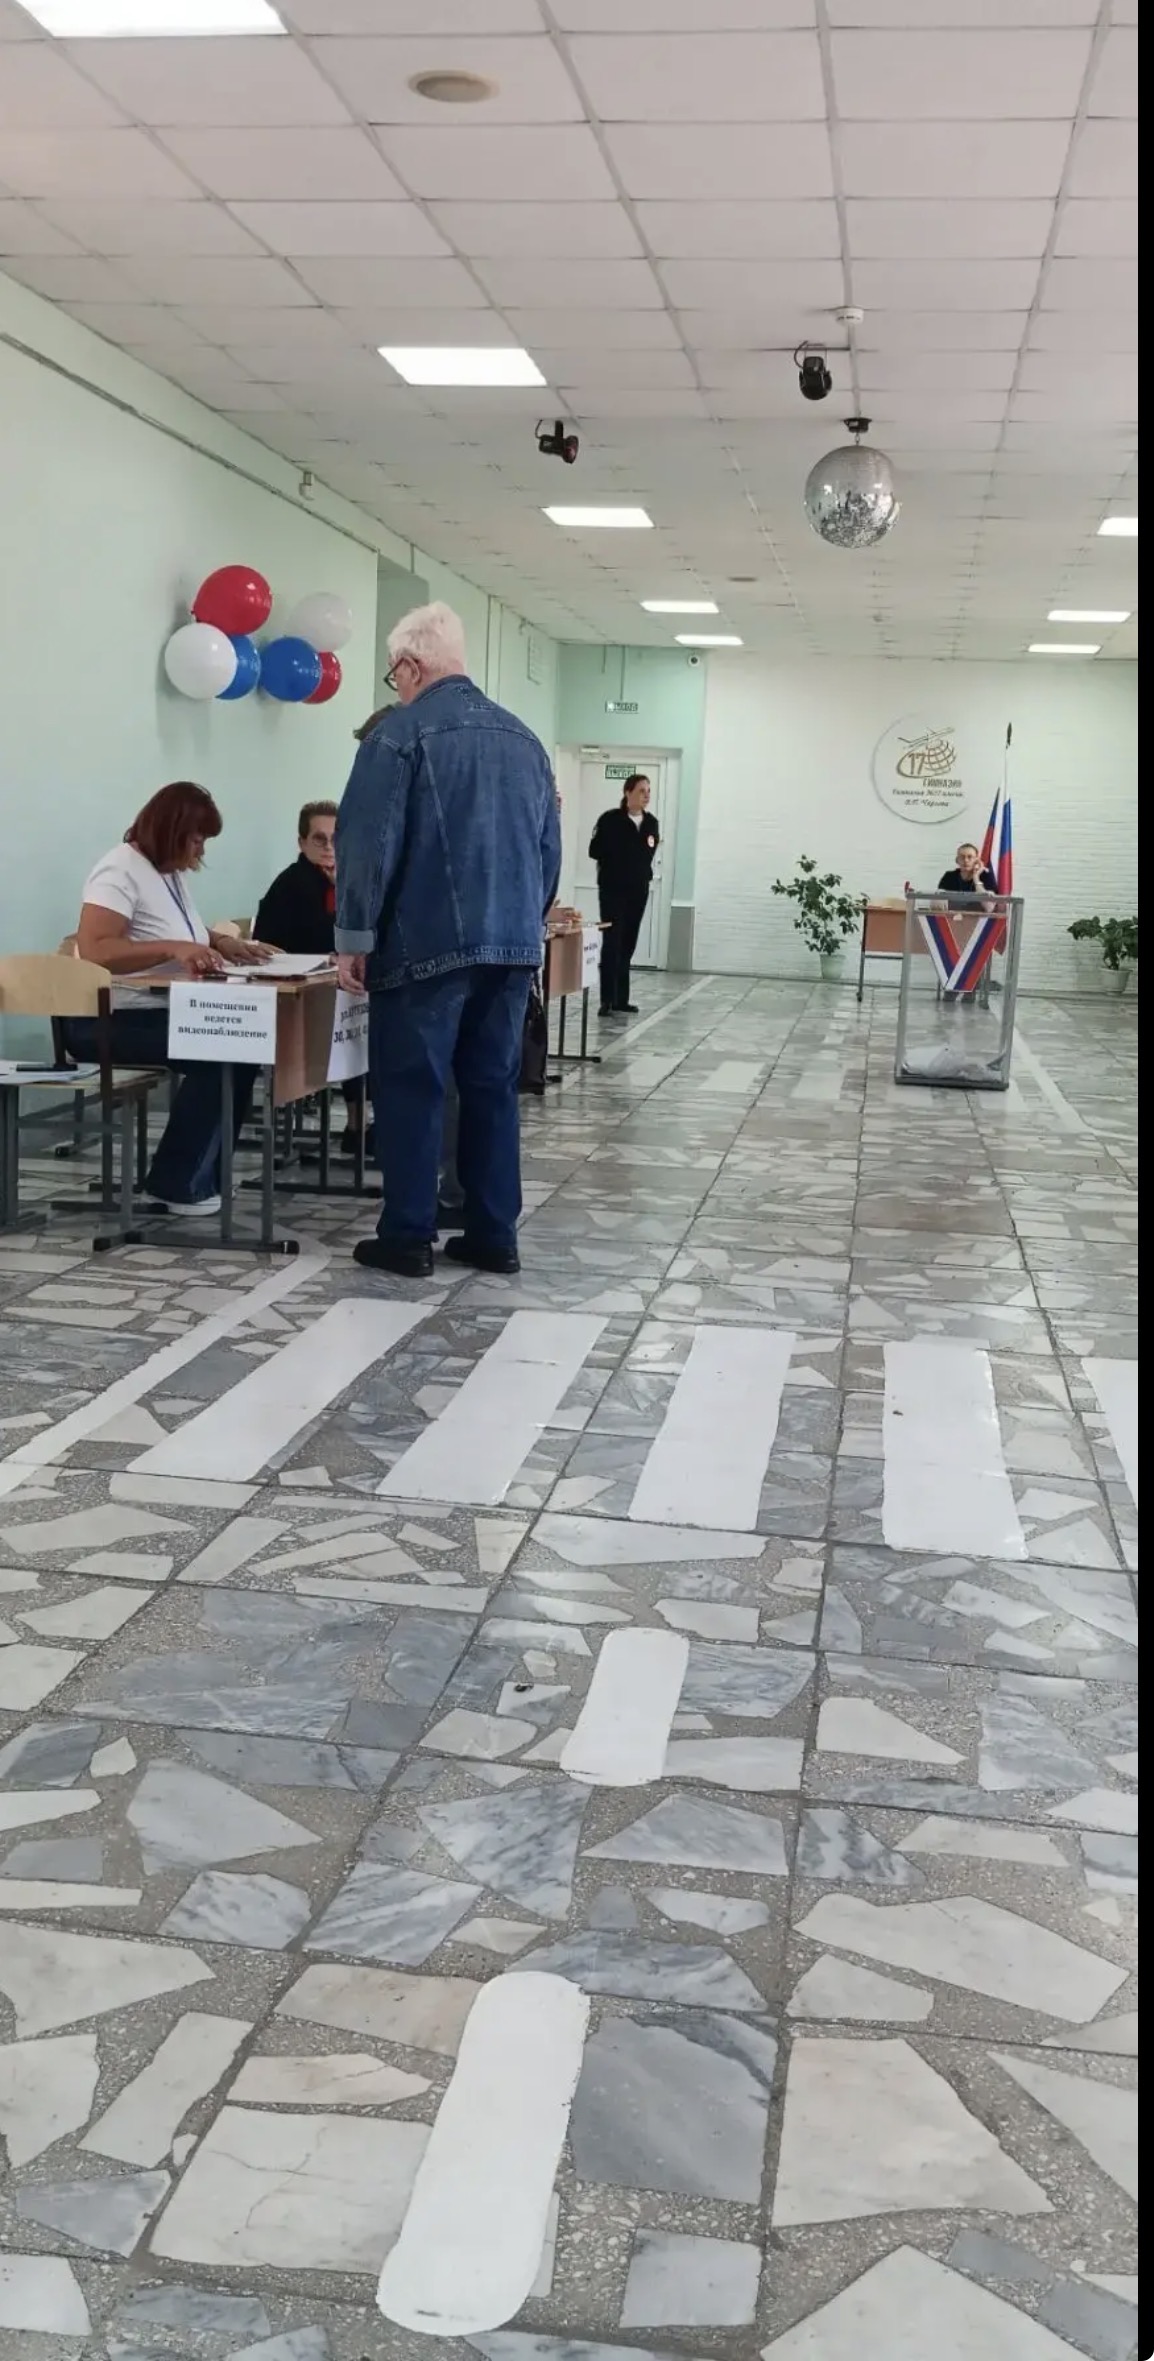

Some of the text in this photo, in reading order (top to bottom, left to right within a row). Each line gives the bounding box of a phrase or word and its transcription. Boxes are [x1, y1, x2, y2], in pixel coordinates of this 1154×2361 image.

[908, 752, 926, 775] 17
[199, 1000, 258, 1012] помещении
[178, 1026, 268, 1039] видеонаблюдение
